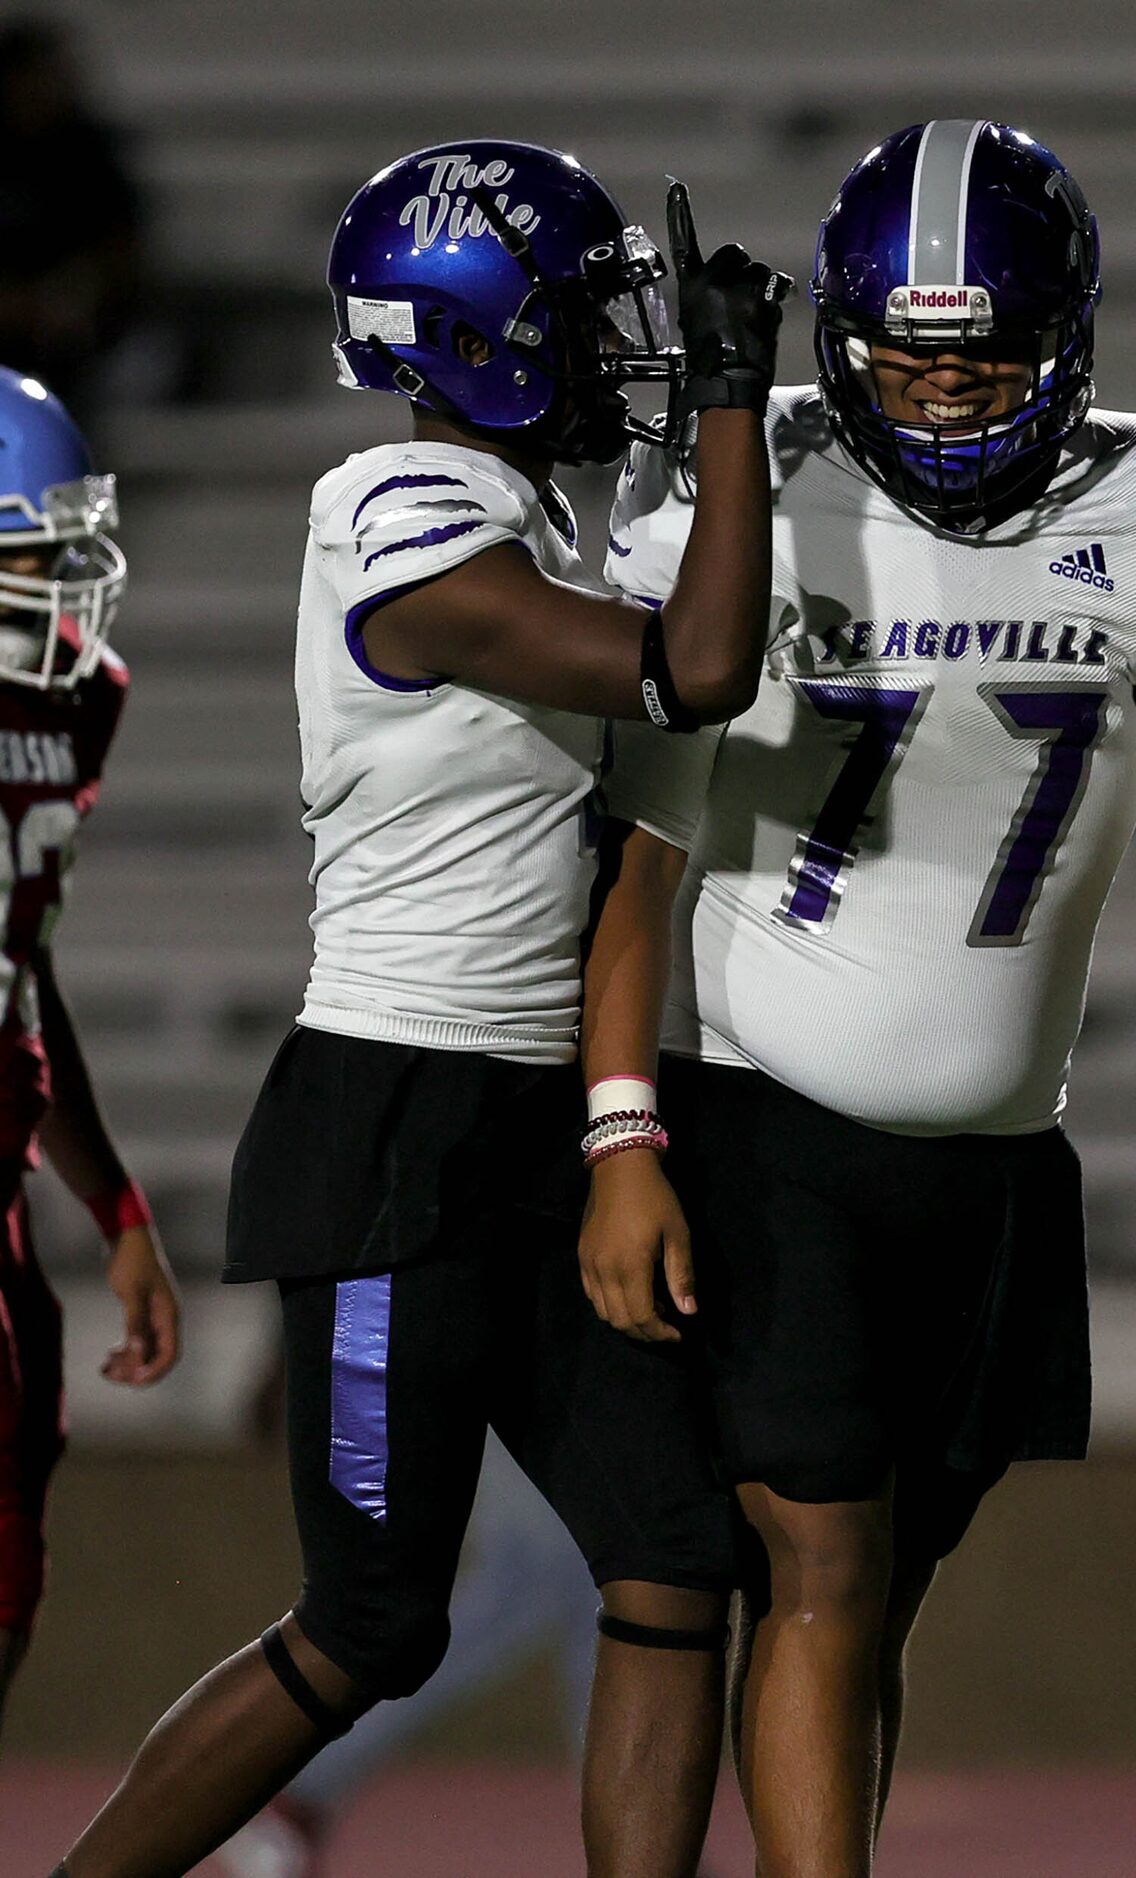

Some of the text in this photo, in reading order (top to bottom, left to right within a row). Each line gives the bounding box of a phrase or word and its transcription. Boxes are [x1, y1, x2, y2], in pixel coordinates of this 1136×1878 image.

[417, 154, 515, 197] The
[764, 274, 778, 301] GRIP
[910, 290, 967, 307] Riddell
[1048, 561, 1115, 592] adidas
[815, 618, 1107, 669] SEAGOVILLE
[769, 672, 1112, 949] 77
